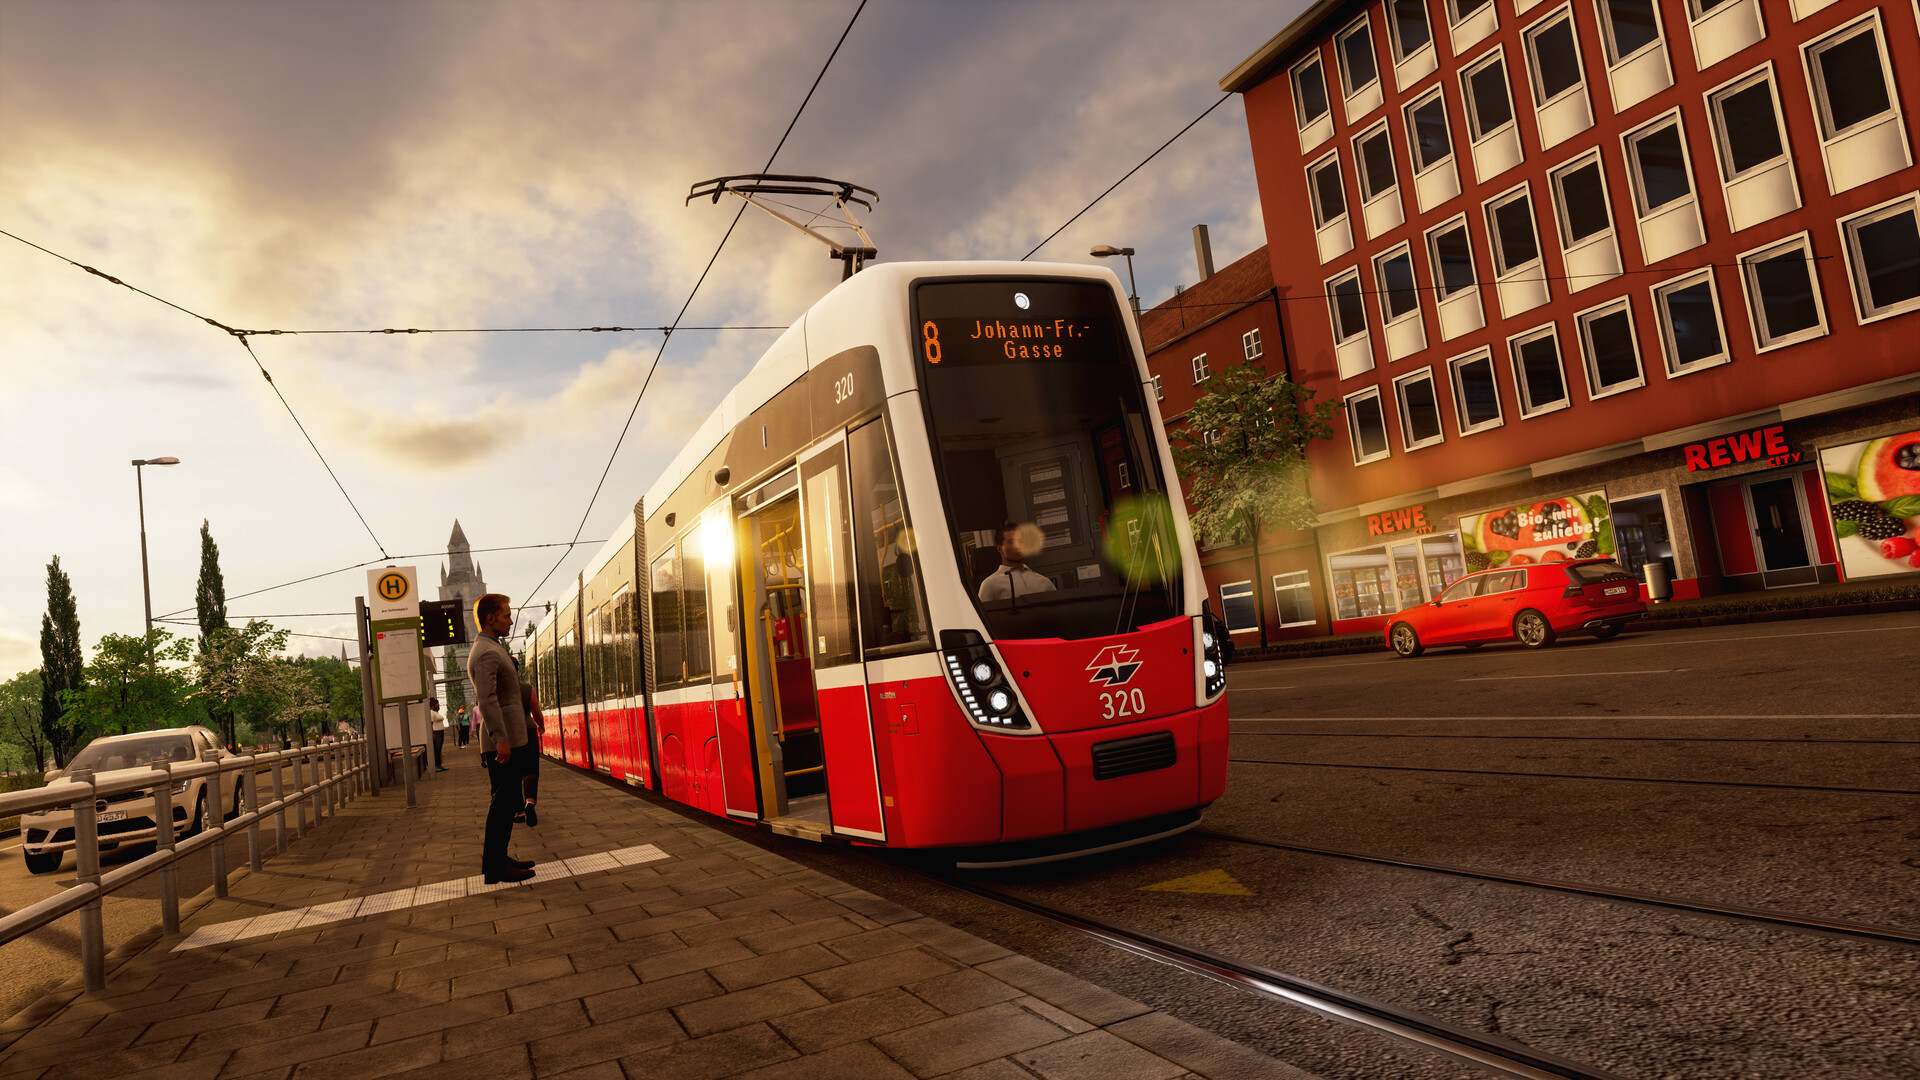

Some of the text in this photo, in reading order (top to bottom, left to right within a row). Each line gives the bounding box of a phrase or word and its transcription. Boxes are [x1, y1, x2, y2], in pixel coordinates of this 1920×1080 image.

[970, 319, 1090, 339] Johann-Fr.-
[923, 320, 942, 364] 8
[1004, 340, 1063, 359] Gasse
[834, 371, 854, 405] 320
[1684, 425, 1789, 472] REWE
[1767, 452, 1801, 467] CITY
[1367, 505, 1427, 537] REWE
[1517, 503, 1580, 527] Bio, mir
[1414, 525, 1433, 536] CITY
[1533, 517, 1600, 542] zuliebe!
[386, 579, 400, 595] H
[1098, 687, 1146, 720] 320
